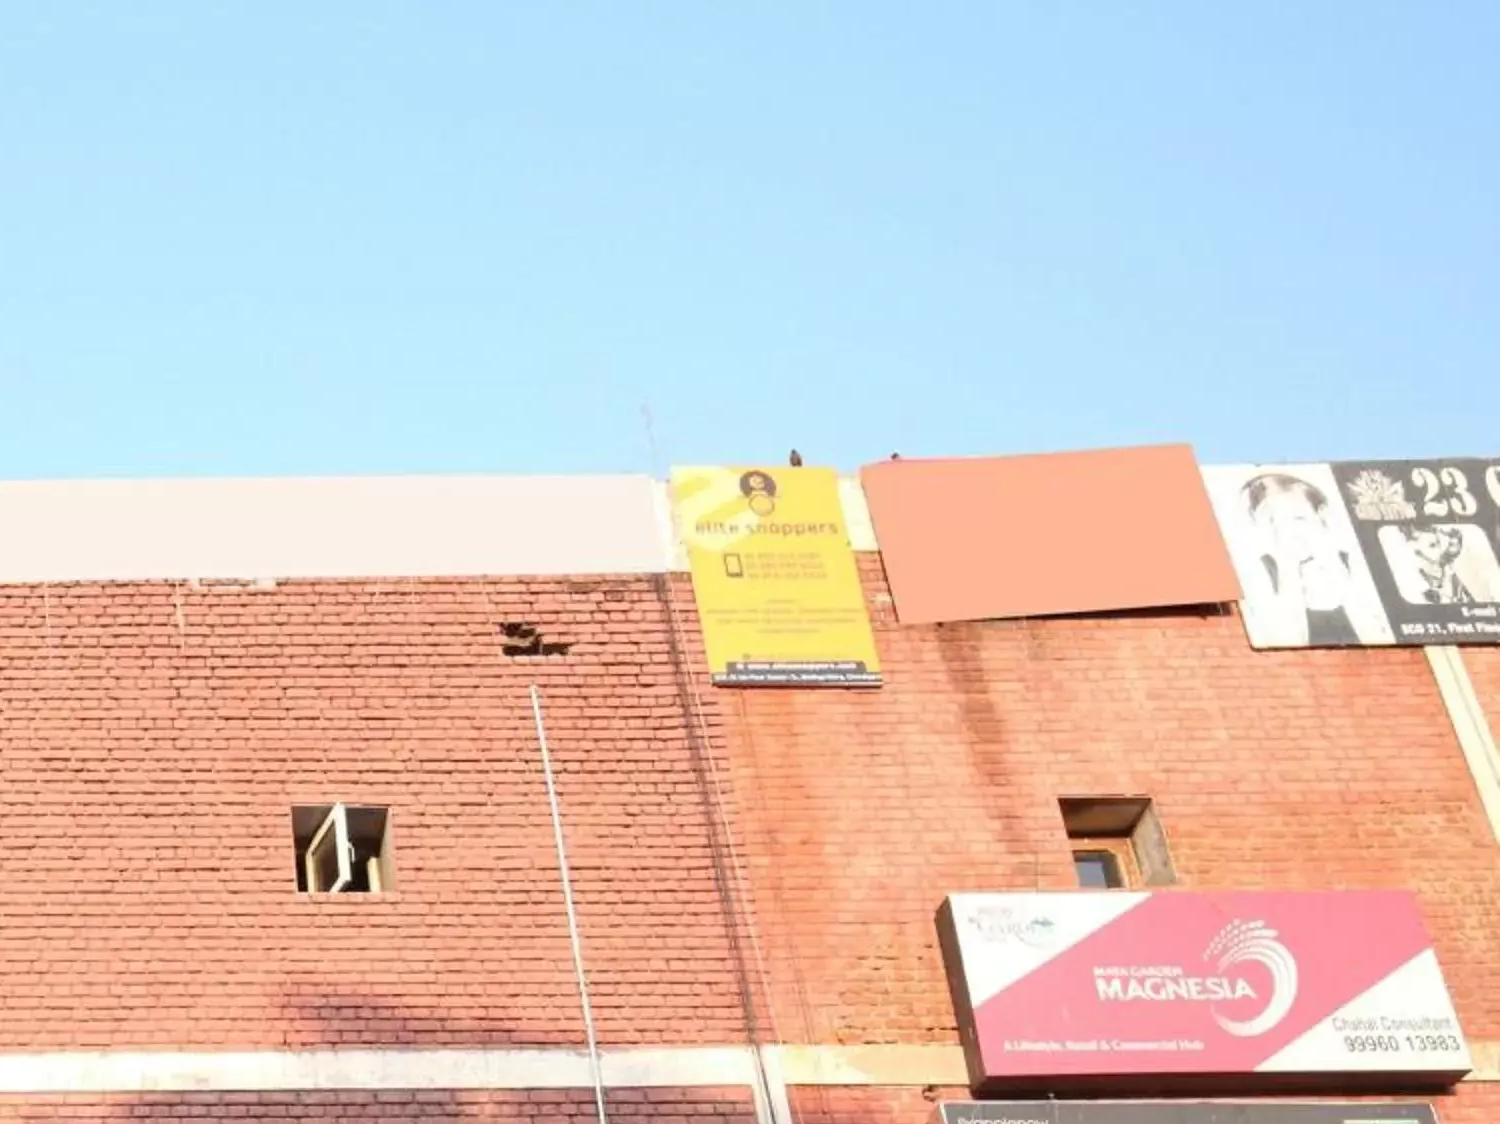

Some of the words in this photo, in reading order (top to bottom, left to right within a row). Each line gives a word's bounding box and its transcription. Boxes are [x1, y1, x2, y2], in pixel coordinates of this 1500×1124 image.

[1411, 467, 1477, 516] 23
[1095, 976, 1257, 1001] MAGNESIA
[1380, 1016, 1451, 1031] Consultant
